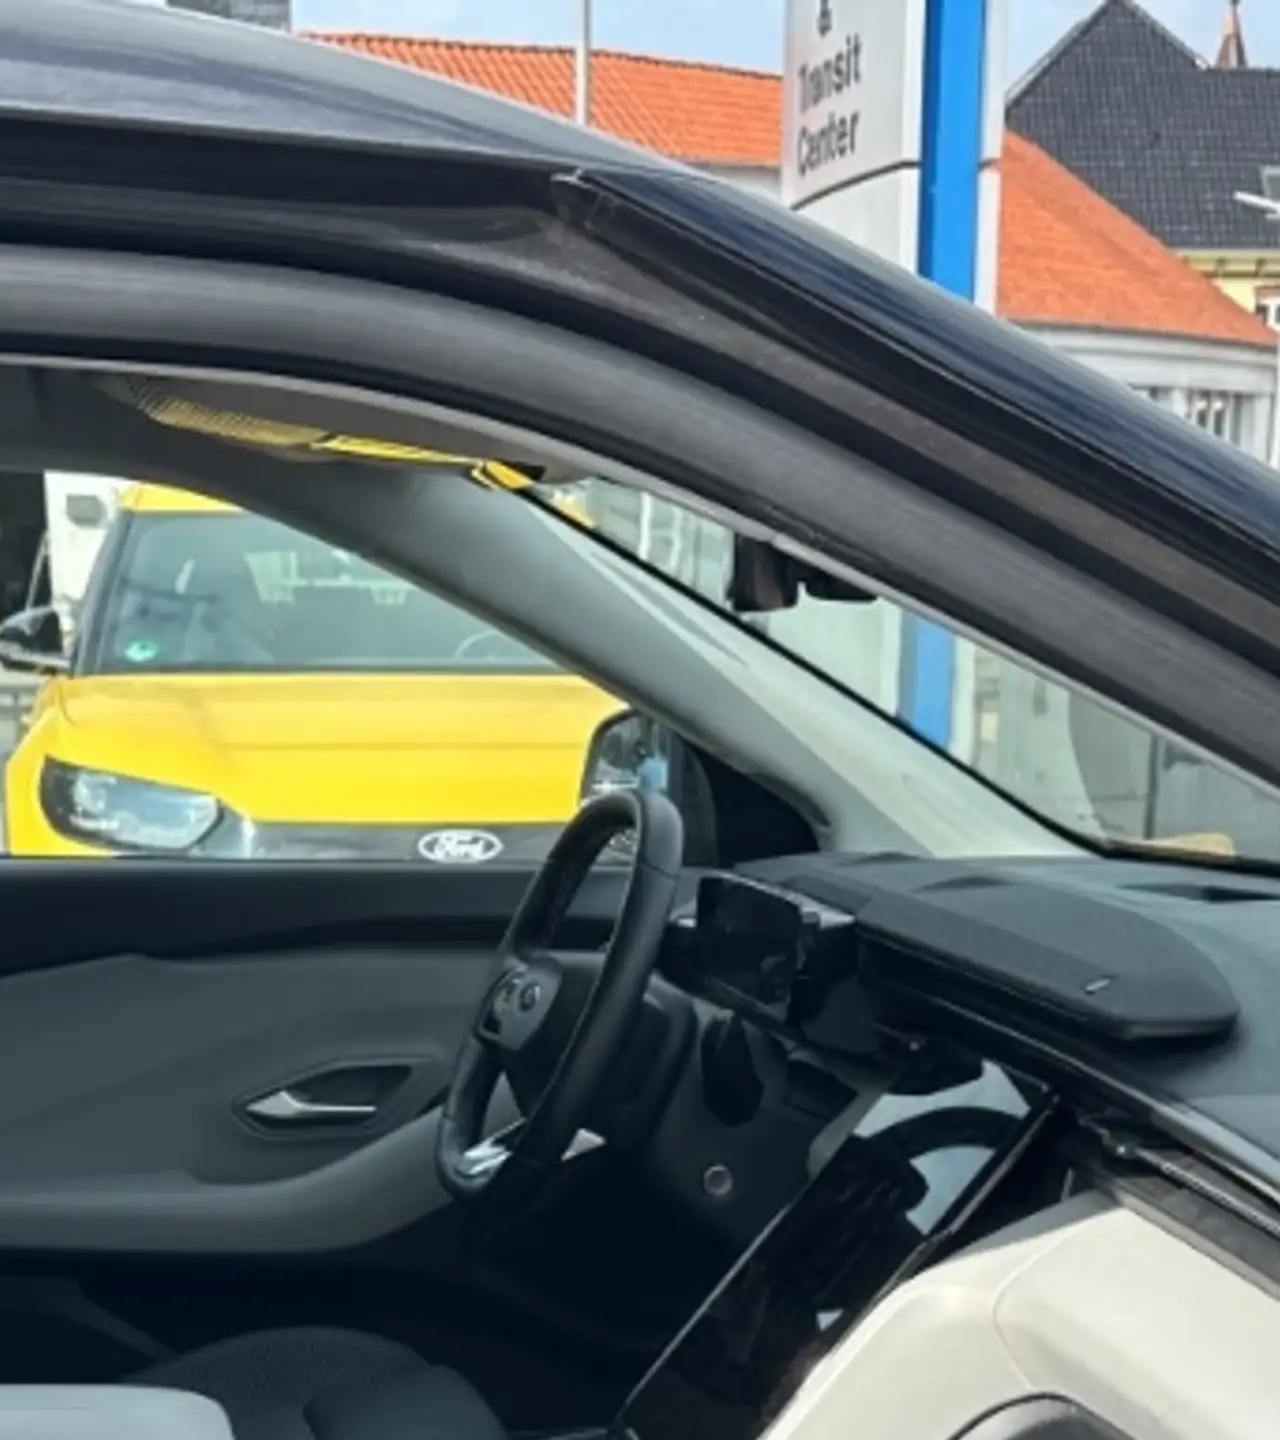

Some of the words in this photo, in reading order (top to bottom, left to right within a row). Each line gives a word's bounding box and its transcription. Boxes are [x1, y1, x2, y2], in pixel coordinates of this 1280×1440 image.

[799, 33, 862, 116] Transit
[798, 110, 860, 177] Center
[426, 830, 492, 861] Ford
